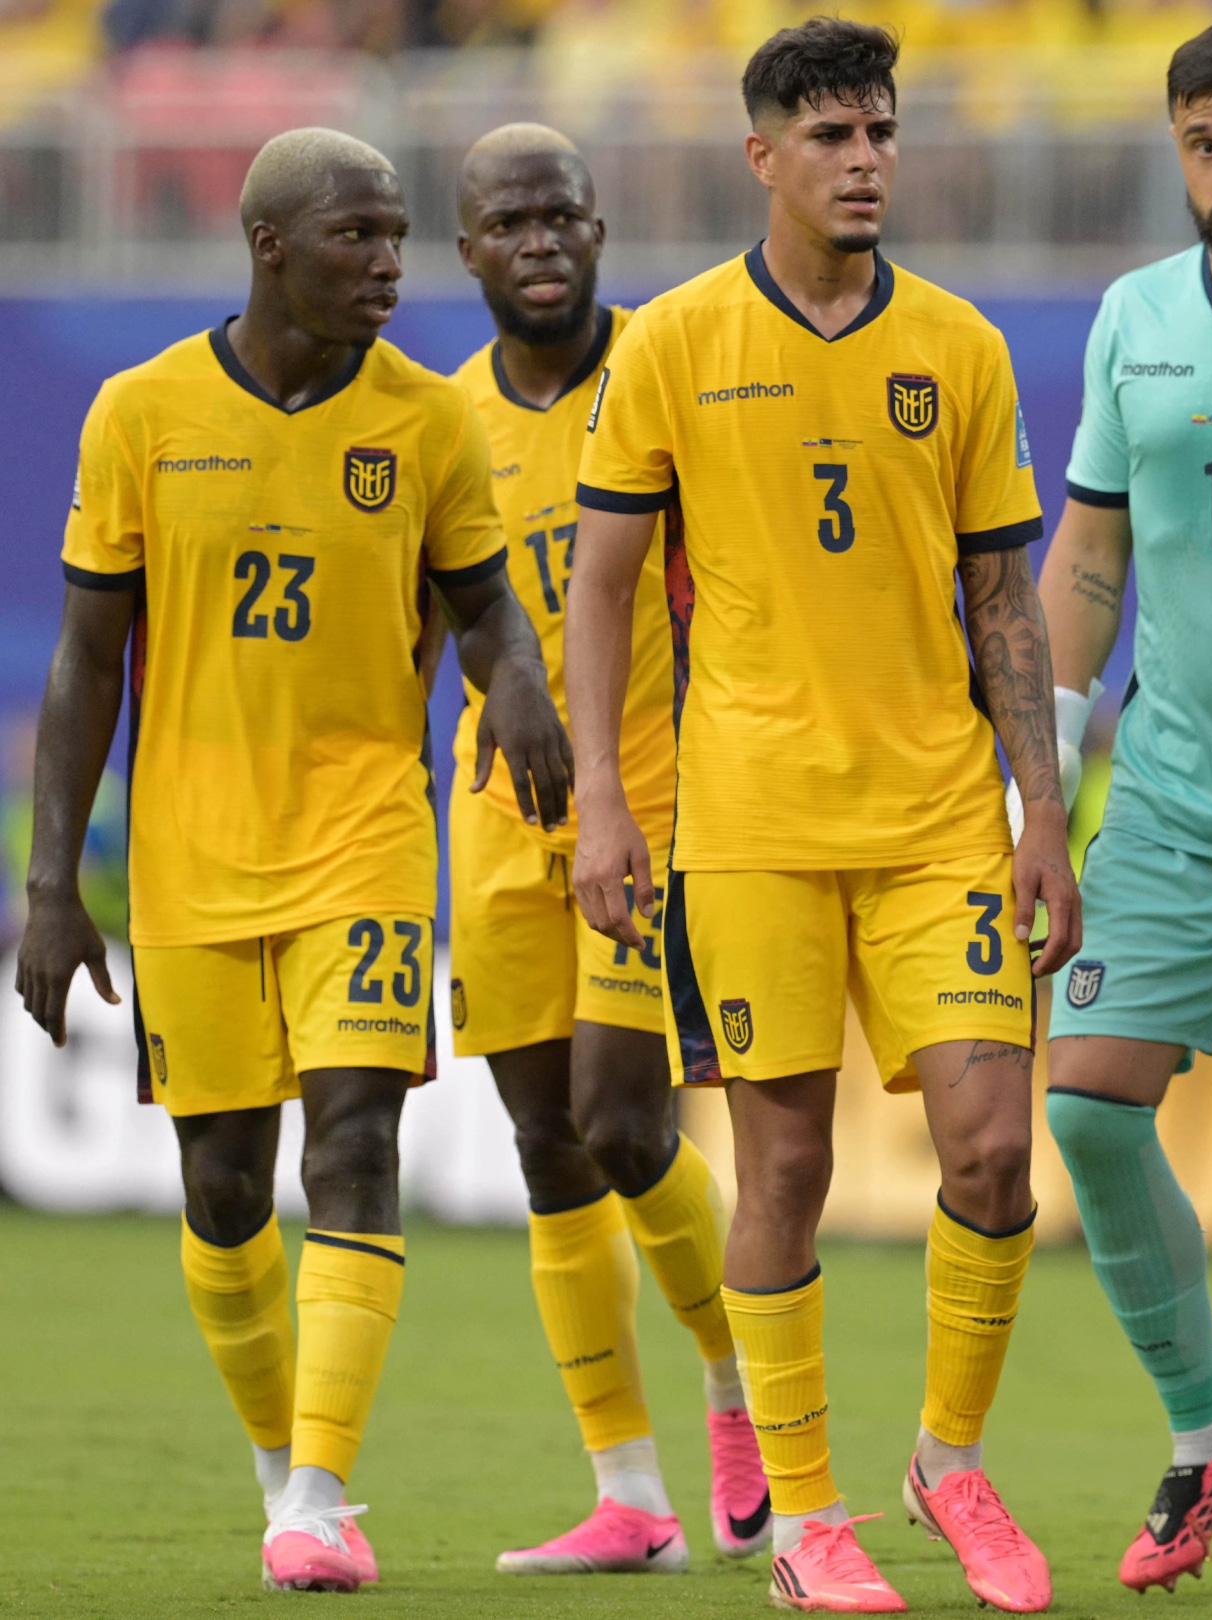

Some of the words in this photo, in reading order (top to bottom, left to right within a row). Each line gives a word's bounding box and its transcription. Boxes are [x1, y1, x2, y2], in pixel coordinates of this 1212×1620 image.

[1120, 361, 1194, 378] marathon
[698, 382, 794, 406] marathon
[158, 456, 253, 473] marathon
[814, 464, 855, 553] 3
[232, 550, 315, 642] 23
[966, 891, 1003, 975] 3
[348, 918, 421, 1008] 23
[589, 974, 663, 999] maratho
[938, 988, 1023, 1011] marathon
[338, 1016, 421, 1036] marathon
